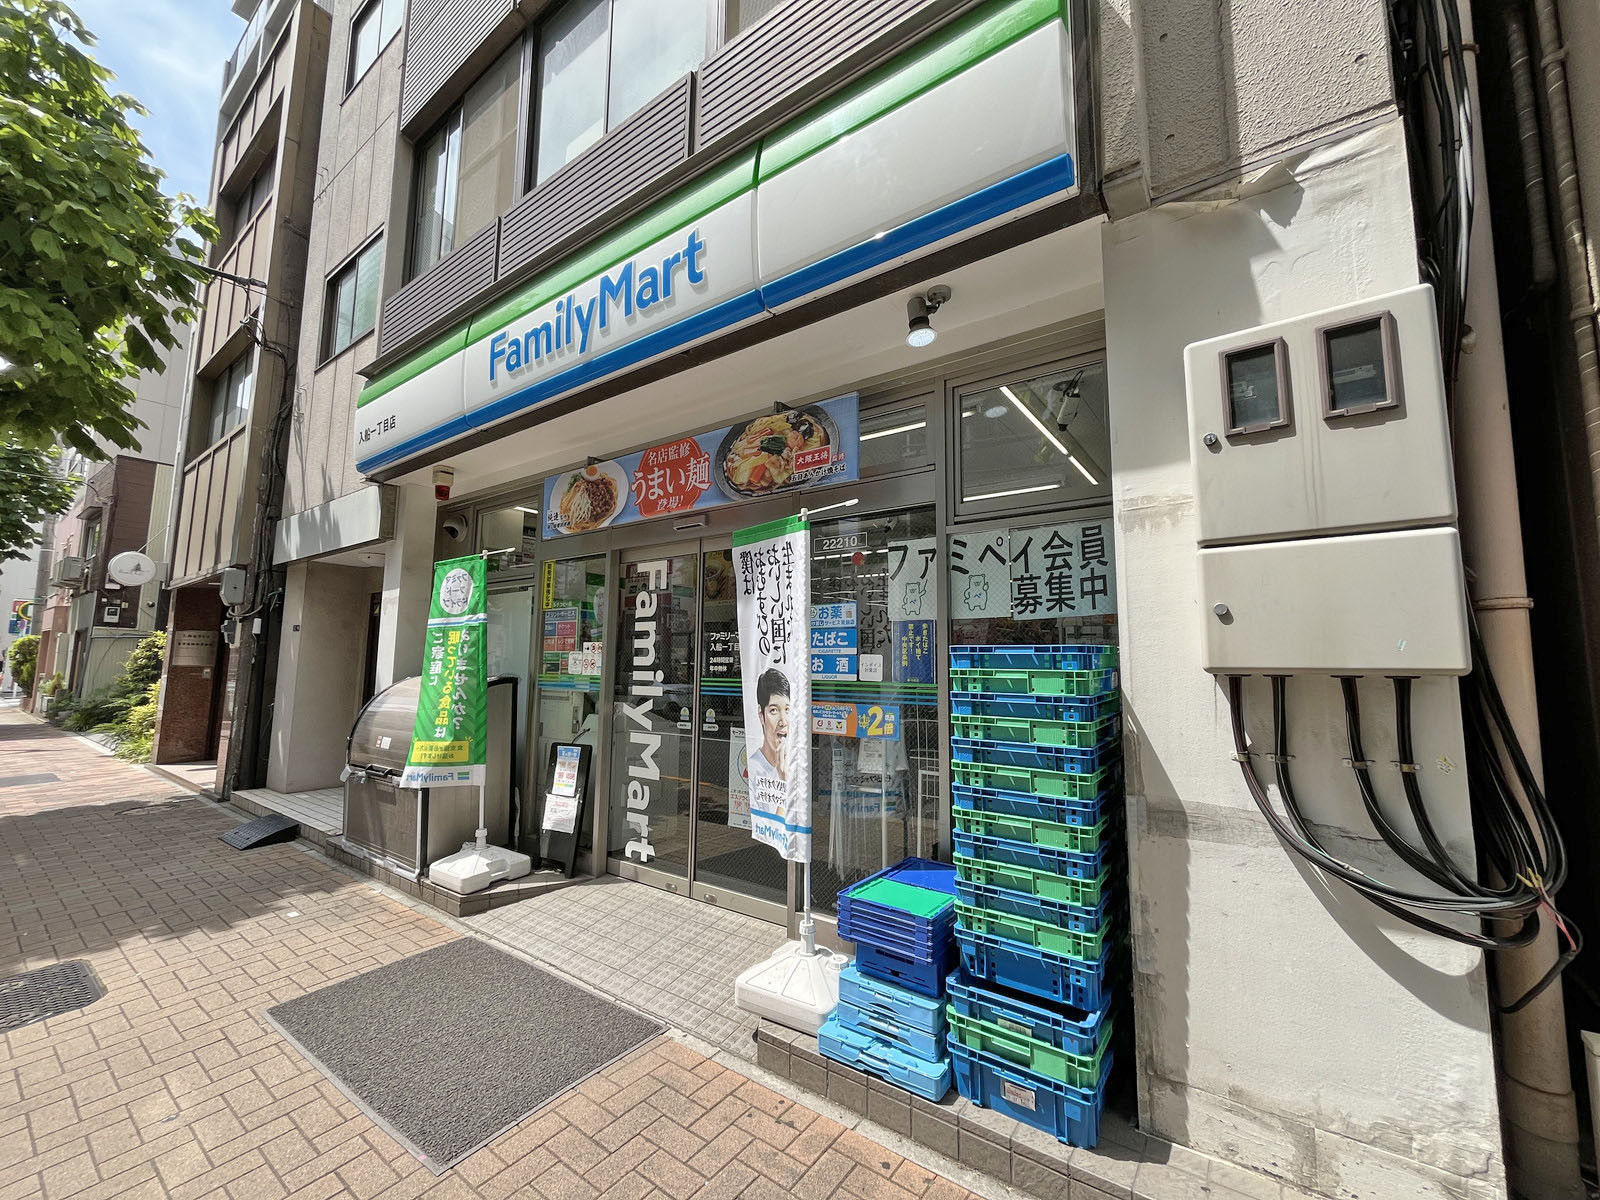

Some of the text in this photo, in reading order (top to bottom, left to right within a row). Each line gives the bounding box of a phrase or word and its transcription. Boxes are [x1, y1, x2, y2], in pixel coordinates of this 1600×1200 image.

[489, 229, 706, 382] FamilyMart
[358, 415, 397, 445] 入船一丁目店
[647, 442, 691, 466] 名店監修
[796, 451, 829, 465] 大阪王将
[631, 453, 712, 505] うまい麺
[822, 536, 858, 550] 22210
[1012, 567, 1108, 615] 募集中
[818, 605, 843, 619] お薬
[812, 631, 848, 646] たばこ
[622, 560, 667, 863] FamilyMart
